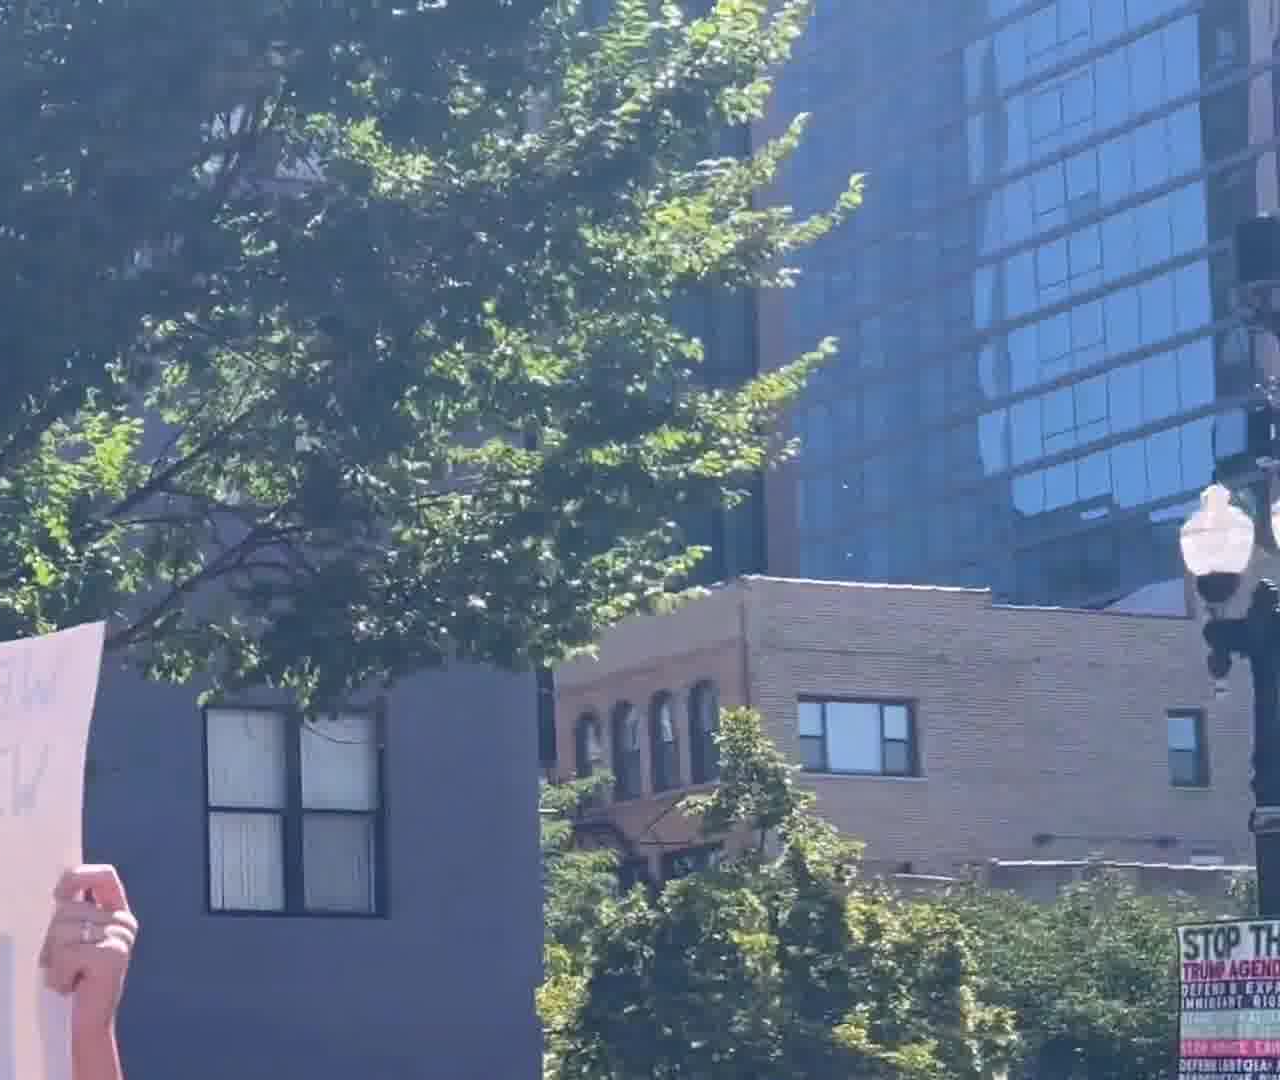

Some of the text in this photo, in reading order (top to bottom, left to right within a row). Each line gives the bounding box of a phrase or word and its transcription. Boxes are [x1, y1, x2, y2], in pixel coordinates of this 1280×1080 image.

[1183, 924, 1280, 961] STOP TH
[1183, 959, 1280, 981] TRUMP AGEND
[1245, 978, 1280, 996] EXPA
